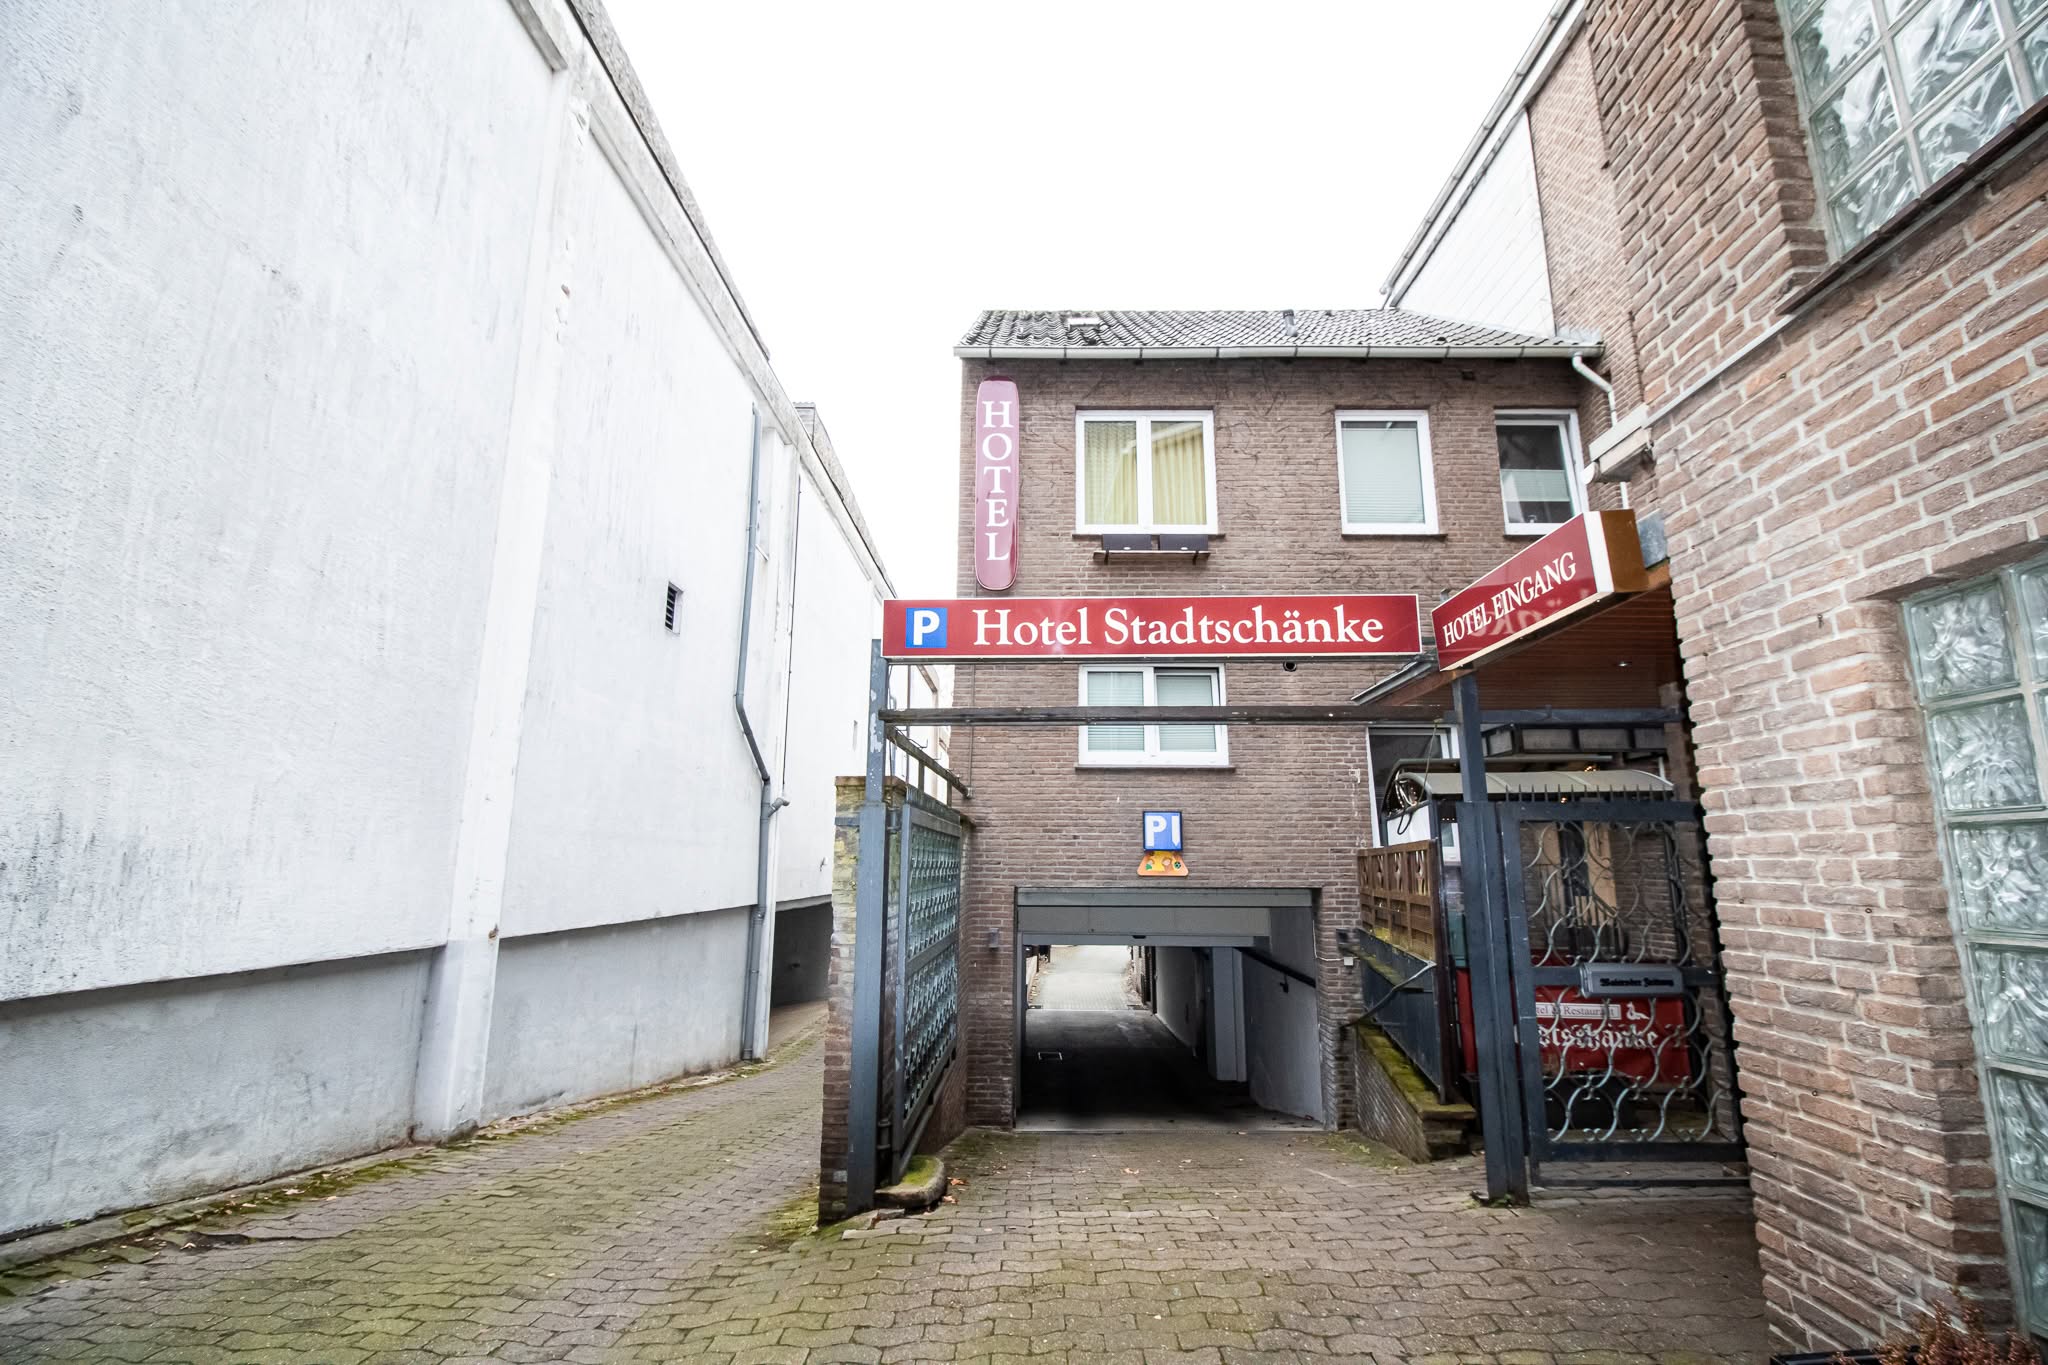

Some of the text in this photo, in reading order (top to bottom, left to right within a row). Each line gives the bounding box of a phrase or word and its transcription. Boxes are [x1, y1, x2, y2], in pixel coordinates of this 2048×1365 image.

[982, 400, 1014, 561] HOTEL
[913, 604, 1384, 646] P Hotel Stadtschänke
[1442, 602, 1492, 648] HOTEL
[1491, 551, 1577, 620] EINGANG
[1564, 1006, 1614, 1017] Restaurt
